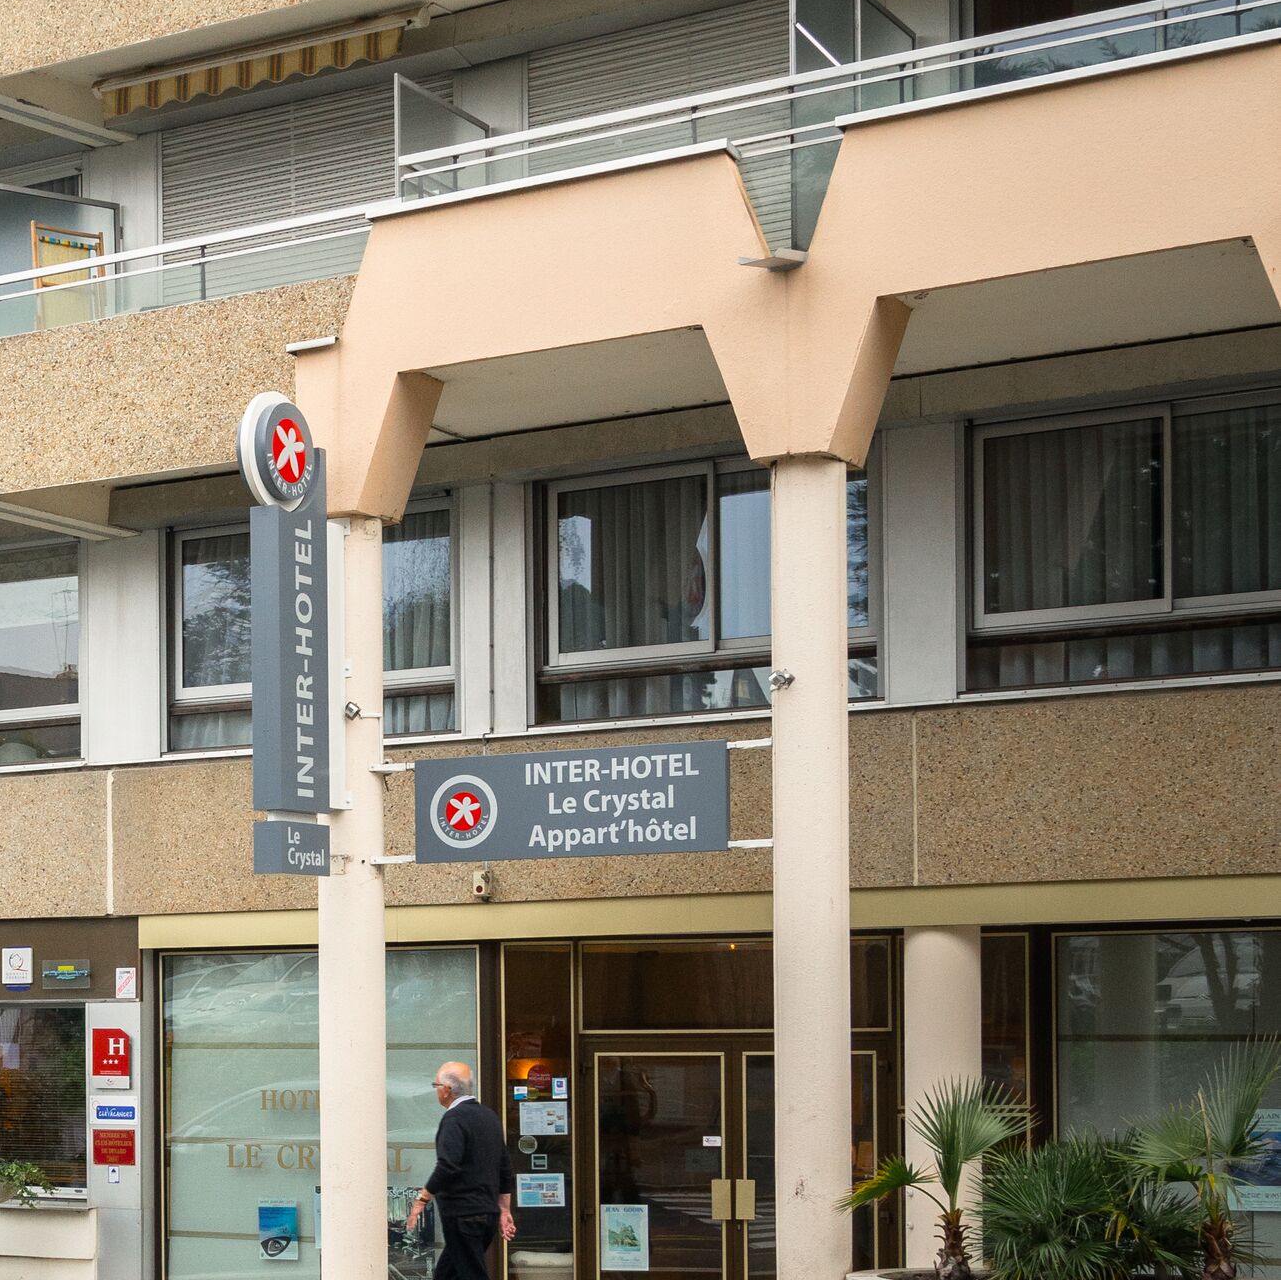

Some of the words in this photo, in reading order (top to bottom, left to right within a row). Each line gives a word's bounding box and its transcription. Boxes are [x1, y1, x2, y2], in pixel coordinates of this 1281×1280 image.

[267, 452, 313, 497] INTER-HOTEL
[295, 519, 315, 798] INTER-HOTEL
[525, 753, 699, 785] INTER-HOTEL
[548, 792, 577, 815] Le
[583, 784, 674, 816] Crystal
[287, 826, 301, 845] Le
[439, 813, 489, 839] INTER-HOTEL
[528, 815, 697, 851] Appart'hôtel
[287, 846, 325, 868] Crystal
[108, 1037, 125, 1056] H
[226, 1144, 263, 1169] LE
